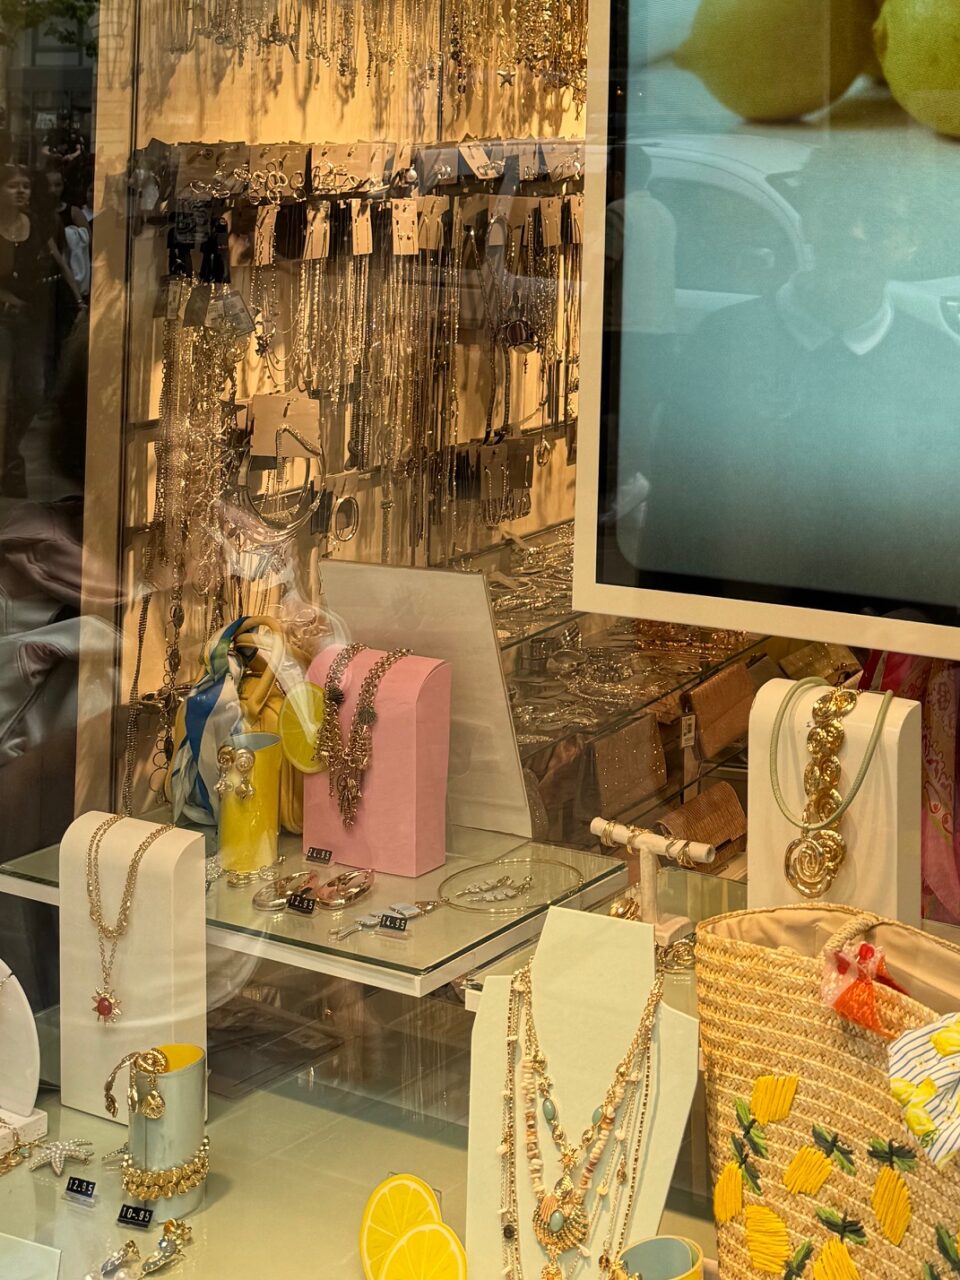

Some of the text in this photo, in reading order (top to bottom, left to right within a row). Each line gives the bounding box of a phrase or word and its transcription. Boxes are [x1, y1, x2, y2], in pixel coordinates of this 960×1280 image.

[308, 848, 330, 860] 24.95
[291, 895, 313, 910] 12.95
[382, 916, 406, 930] 14.95
[69, 1179, 94, 1194] 12.95
